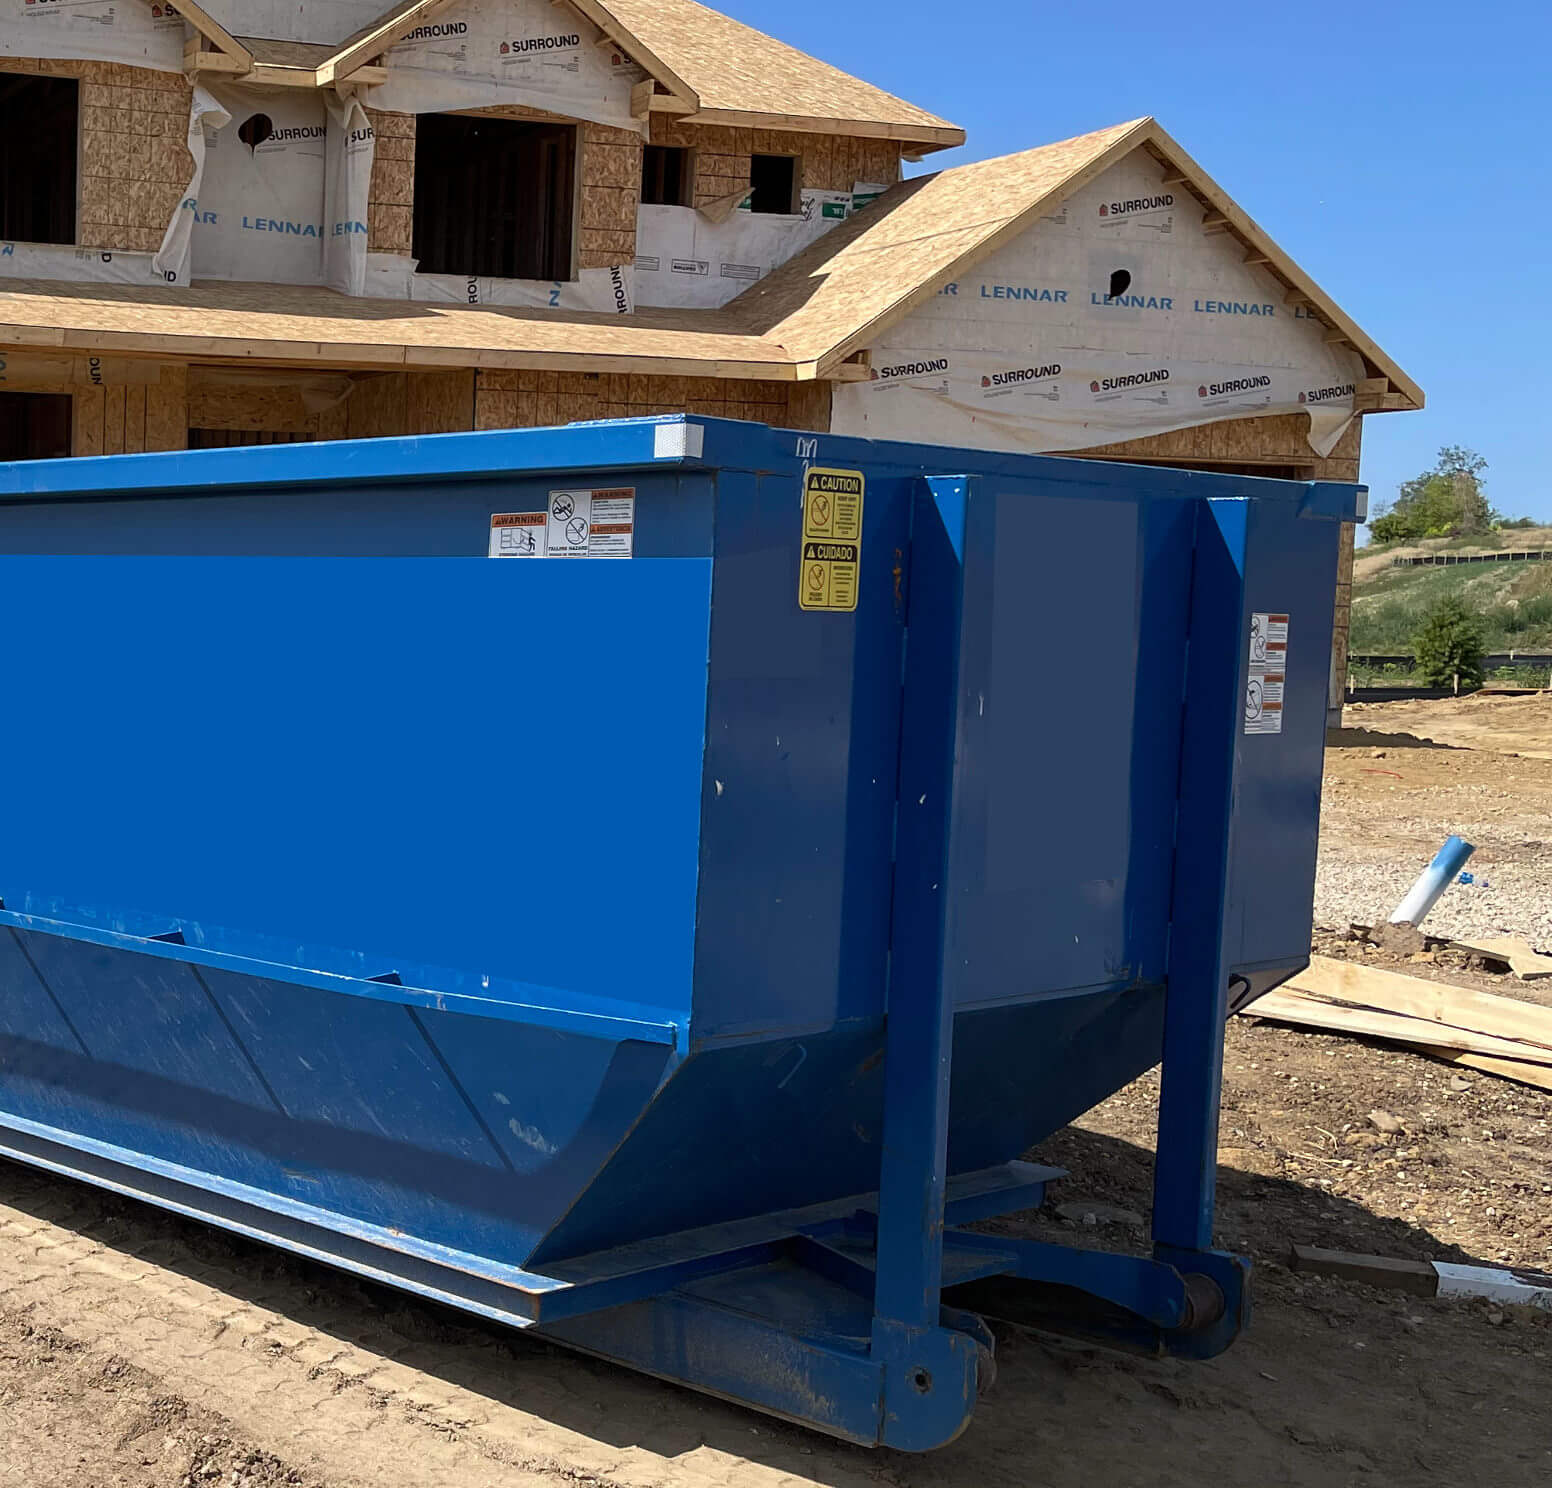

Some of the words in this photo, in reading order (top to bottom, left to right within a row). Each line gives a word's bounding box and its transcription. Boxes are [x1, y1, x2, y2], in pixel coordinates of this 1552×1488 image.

[512, 34, 580, 53] SURROUND
[1111, 195, 1174, 215] SURROUND
[981, 284, 1068, 303] LENNAR
[1091, 292, 1174, 310] LENNAR
[1194, 300, 1274, 316] LENNAR
[881, 358, 948, 379] SURROUND
[992, 364, 1062, 386] SURROUND
[1102, 369, 1169, 391] SURROUND
[1209, 375, 1271, 396] SURROUND
[820, 475, 859, 492] CAUTION
[501, 515, 544, 525] WARNING
[817, 545, 853, 560] CUIDADO
